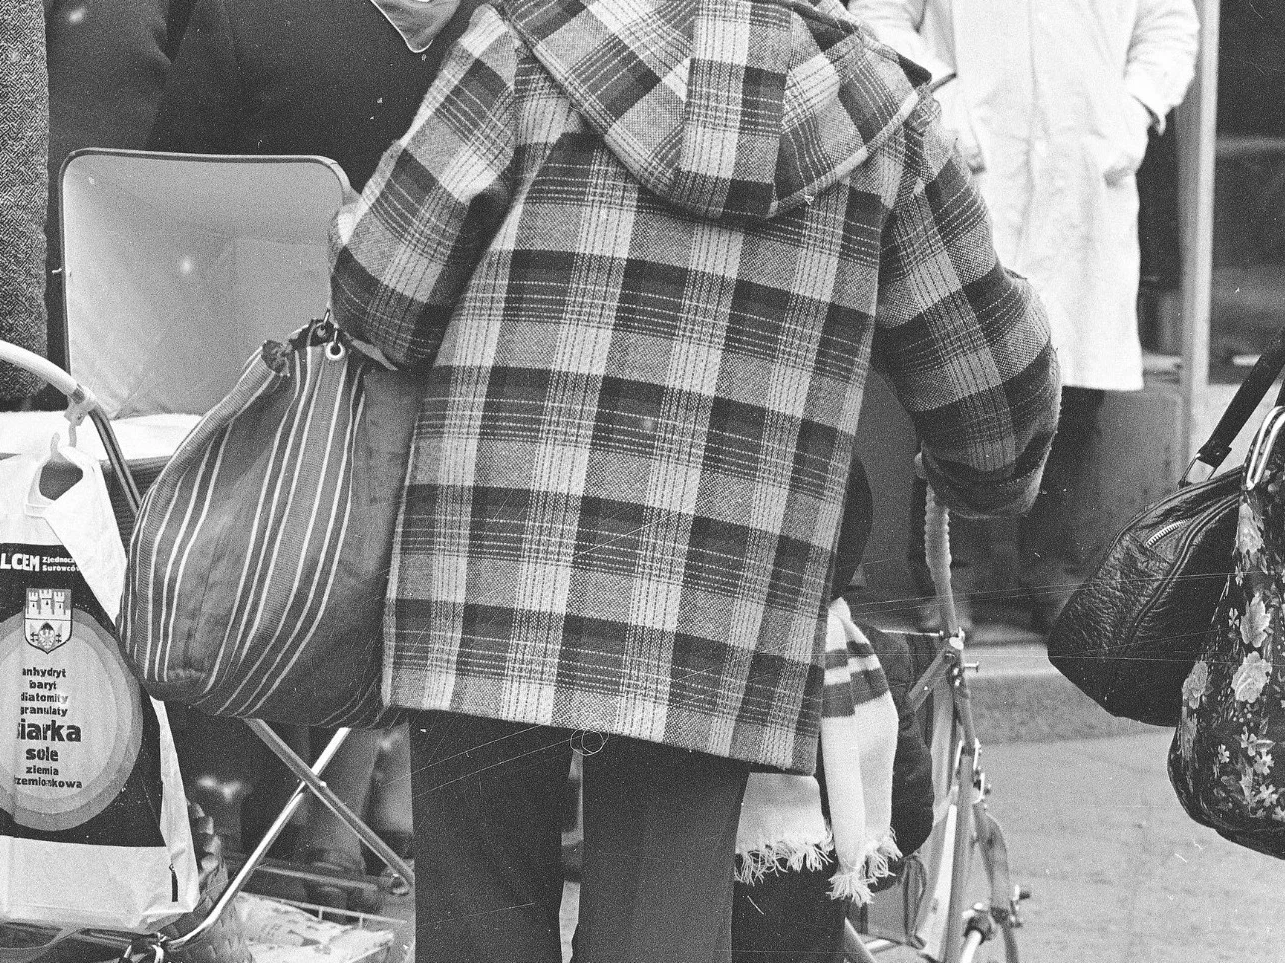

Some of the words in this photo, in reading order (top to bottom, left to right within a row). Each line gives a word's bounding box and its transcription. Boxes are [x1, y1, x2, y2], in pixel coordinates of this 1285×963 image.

[22, 667, 66, 679] anhydryt
[29, 680, 57, 691] baryt
[25, 747, 59, 762] sole
[25, 765, 59, 776] ziemia
